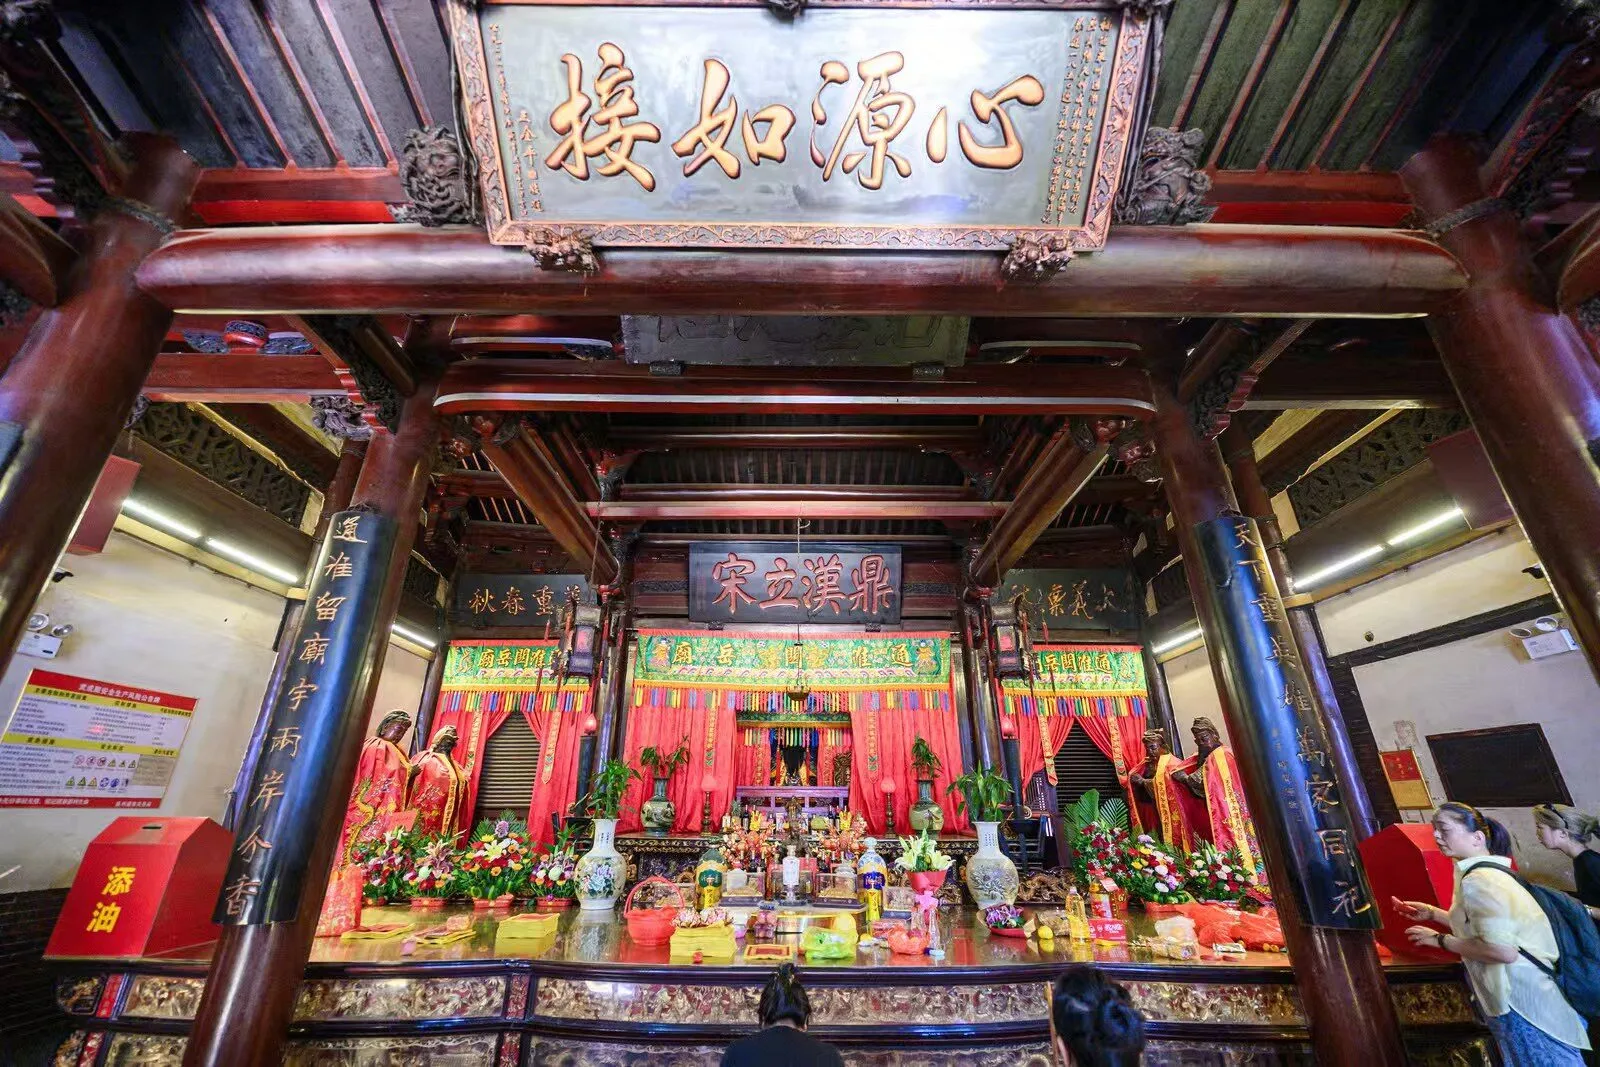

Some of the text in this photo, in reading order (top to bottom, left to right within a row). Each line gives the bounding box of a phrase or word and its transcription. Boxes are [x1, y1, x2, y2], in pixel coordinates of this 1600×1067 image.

[546, 42, 1045, 192] 心源如接
[711, 552, 894, 615] 鼎漢立宋
[671, 643, 913, 668] 通淮關岳廟
[86, 866, 136, 933] 添油
